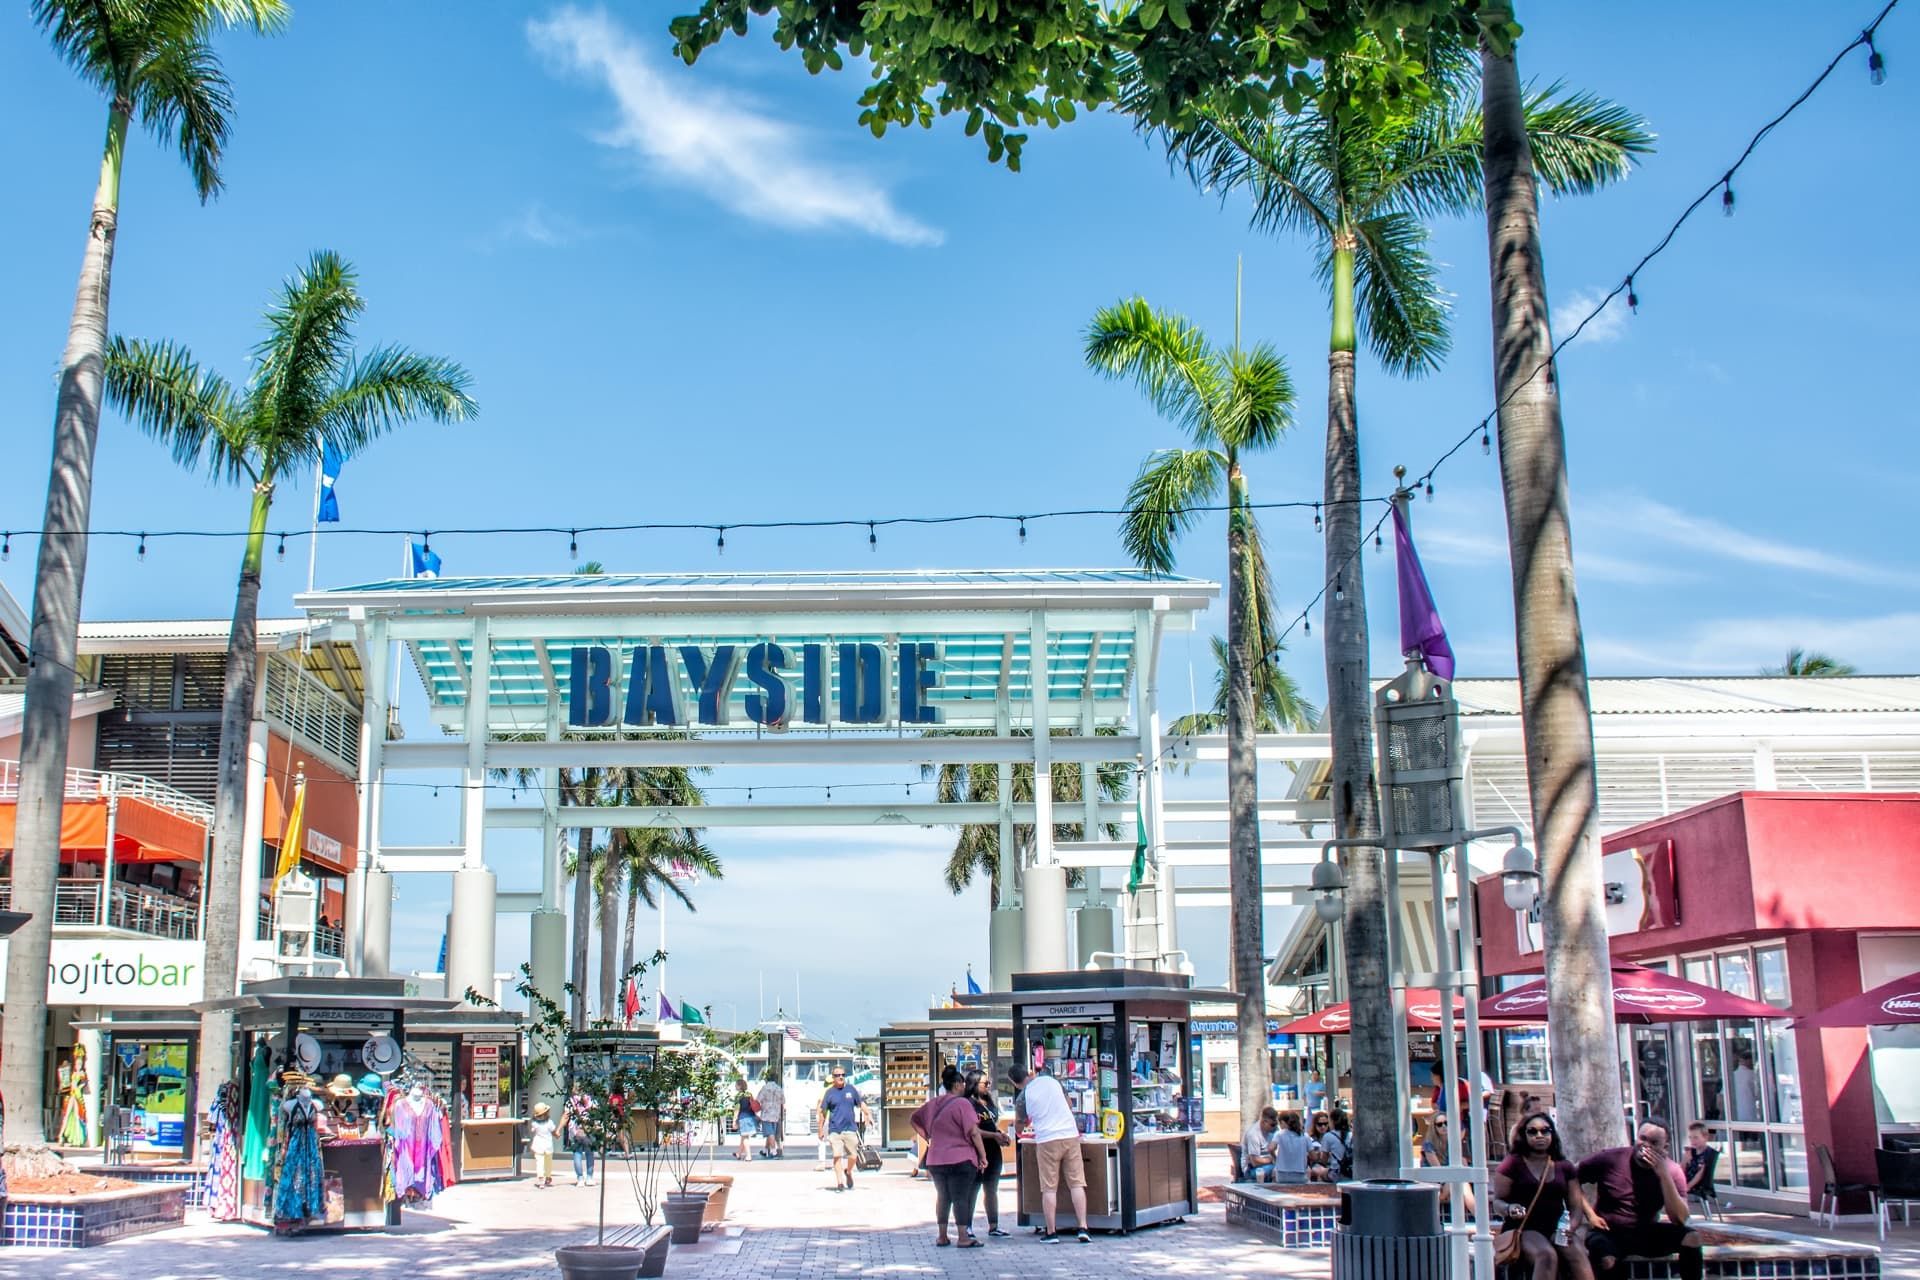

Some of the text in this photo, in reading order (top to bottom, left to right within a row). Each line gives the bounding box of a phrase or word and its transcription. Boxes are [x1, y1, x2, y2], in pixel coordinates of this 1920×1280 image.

[569, 642, 940, 727] BAYSIDE
[1049, 1006, 1077, 1014] CHARGE
[343, 1012, 385, 1020] DESIGNS
